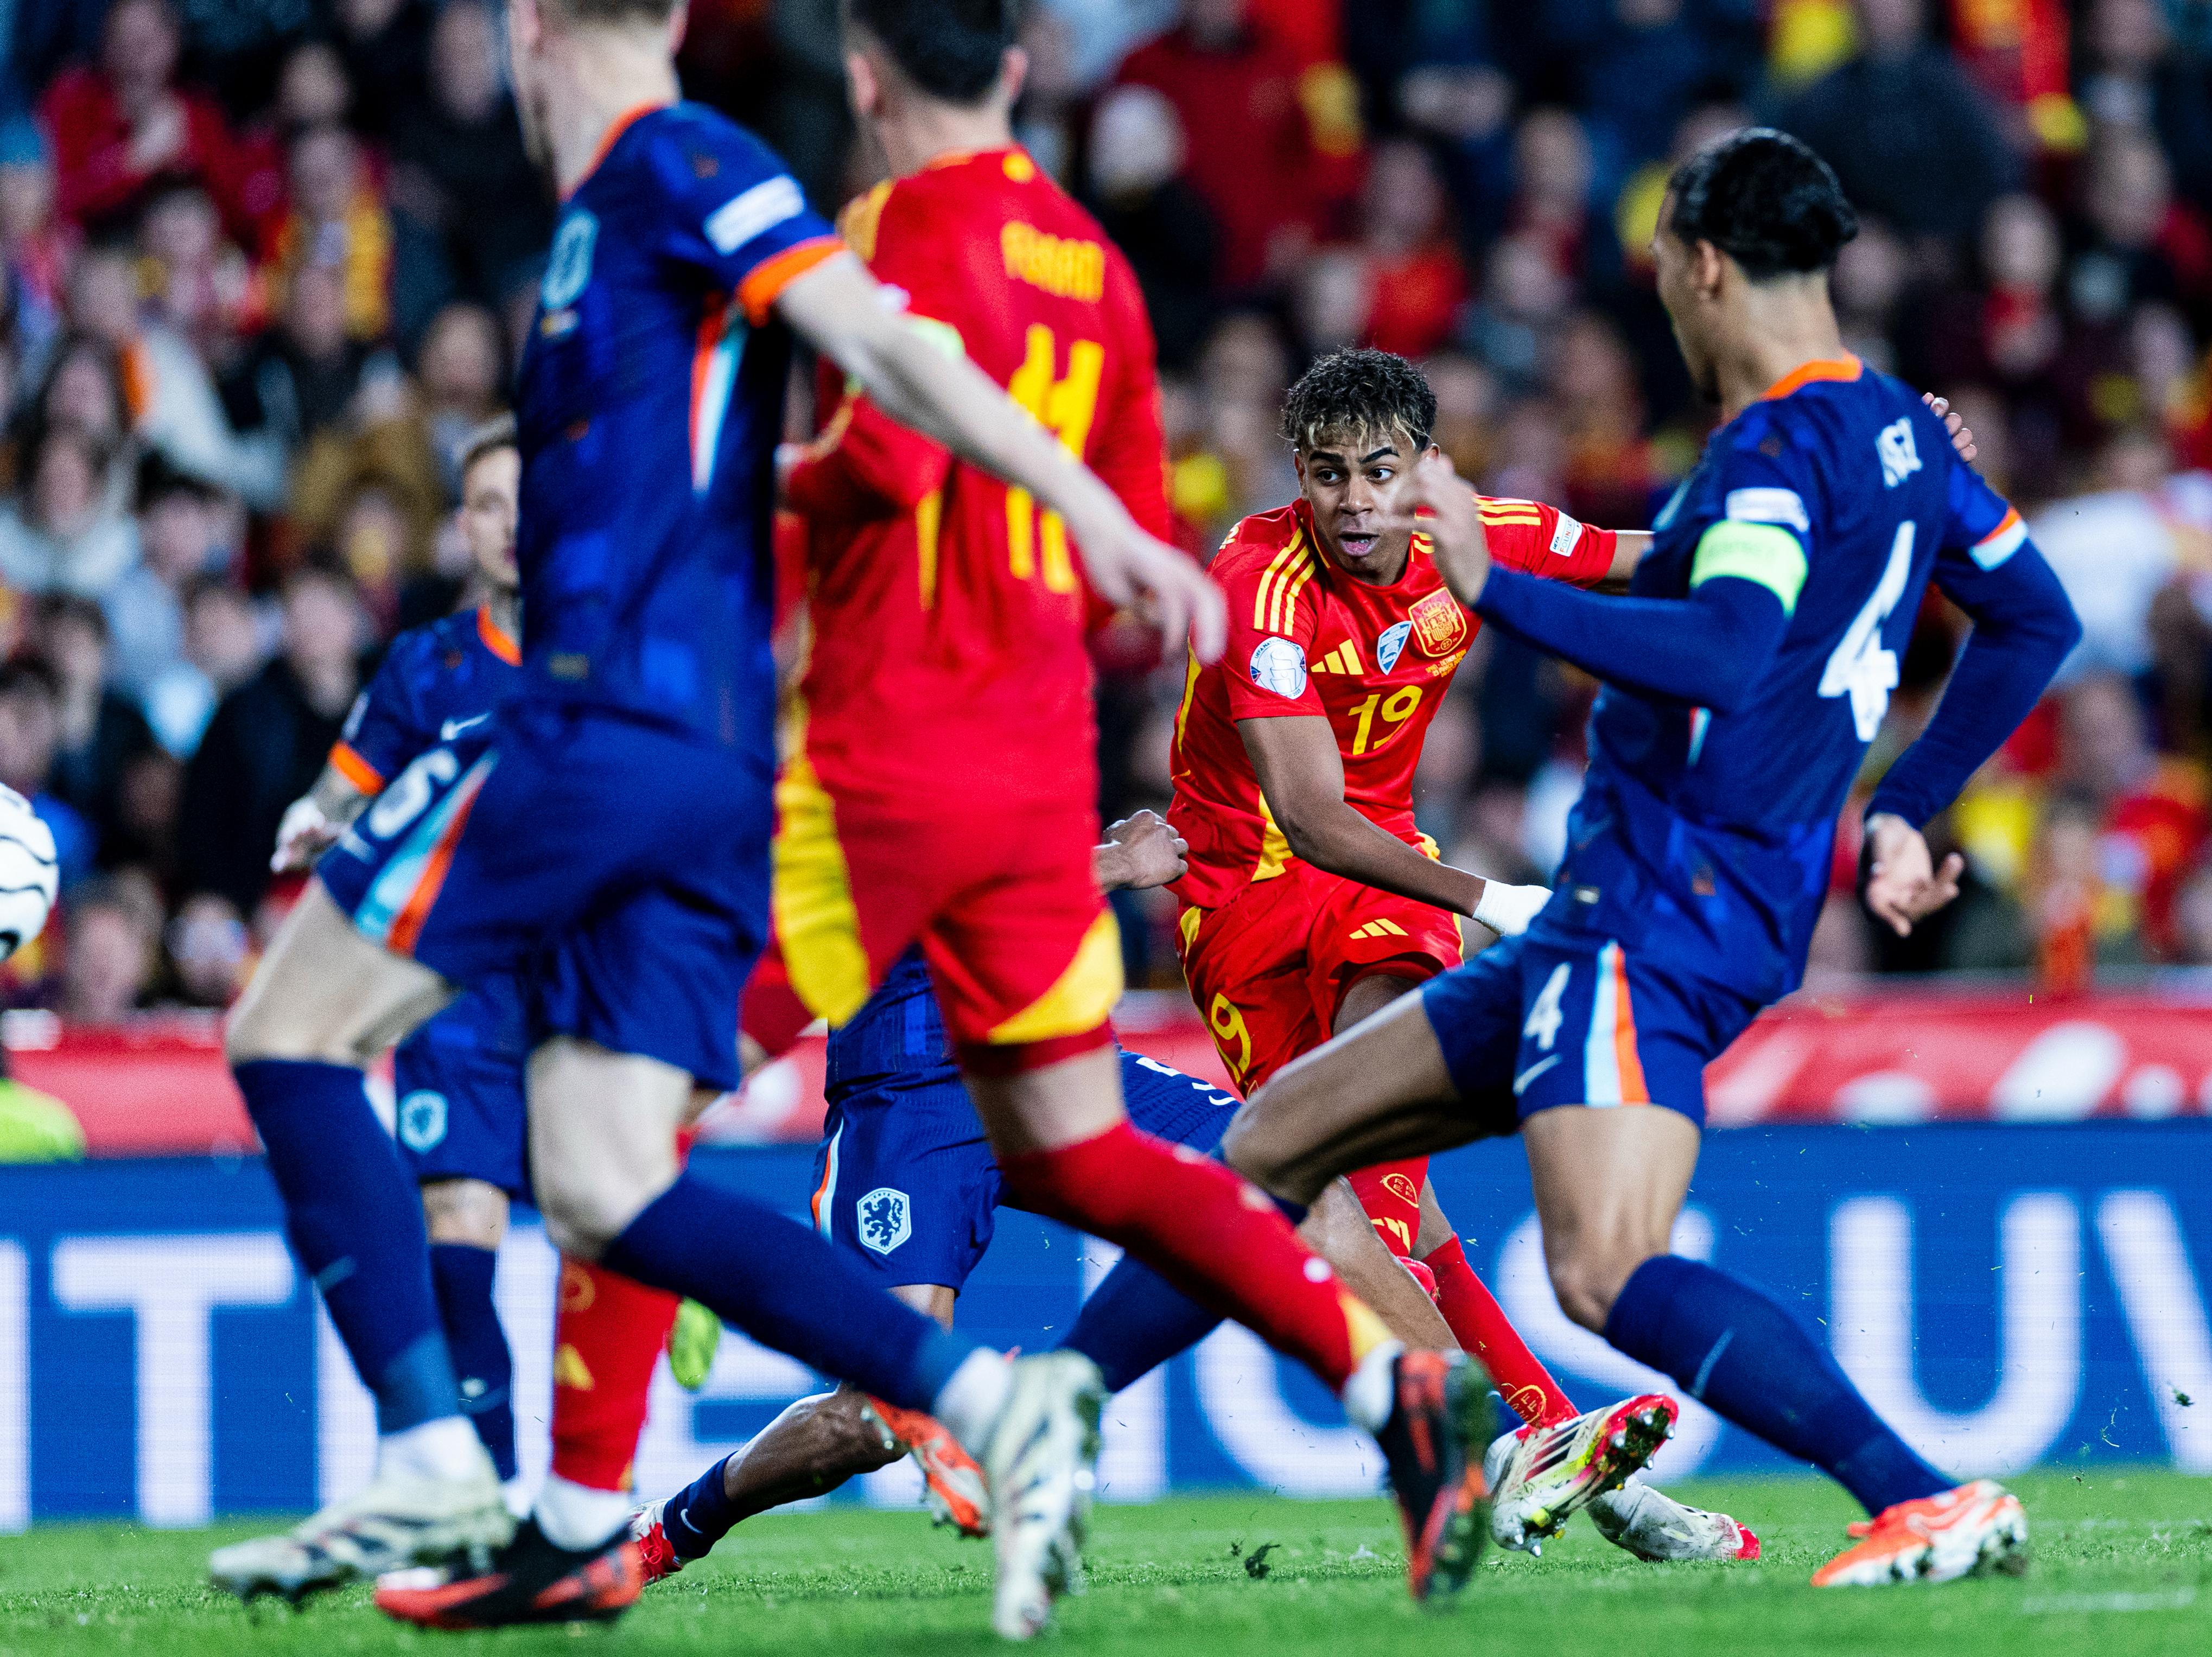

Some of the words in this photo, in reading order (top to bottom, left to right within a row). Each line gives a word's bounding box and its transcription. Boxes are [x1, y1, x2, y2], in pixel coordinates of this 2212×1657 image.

[1817, 520, 1916, 742] 4
[1348, 685, 1423, 756] 19
[1523, 961, 1572, 1052] 4
